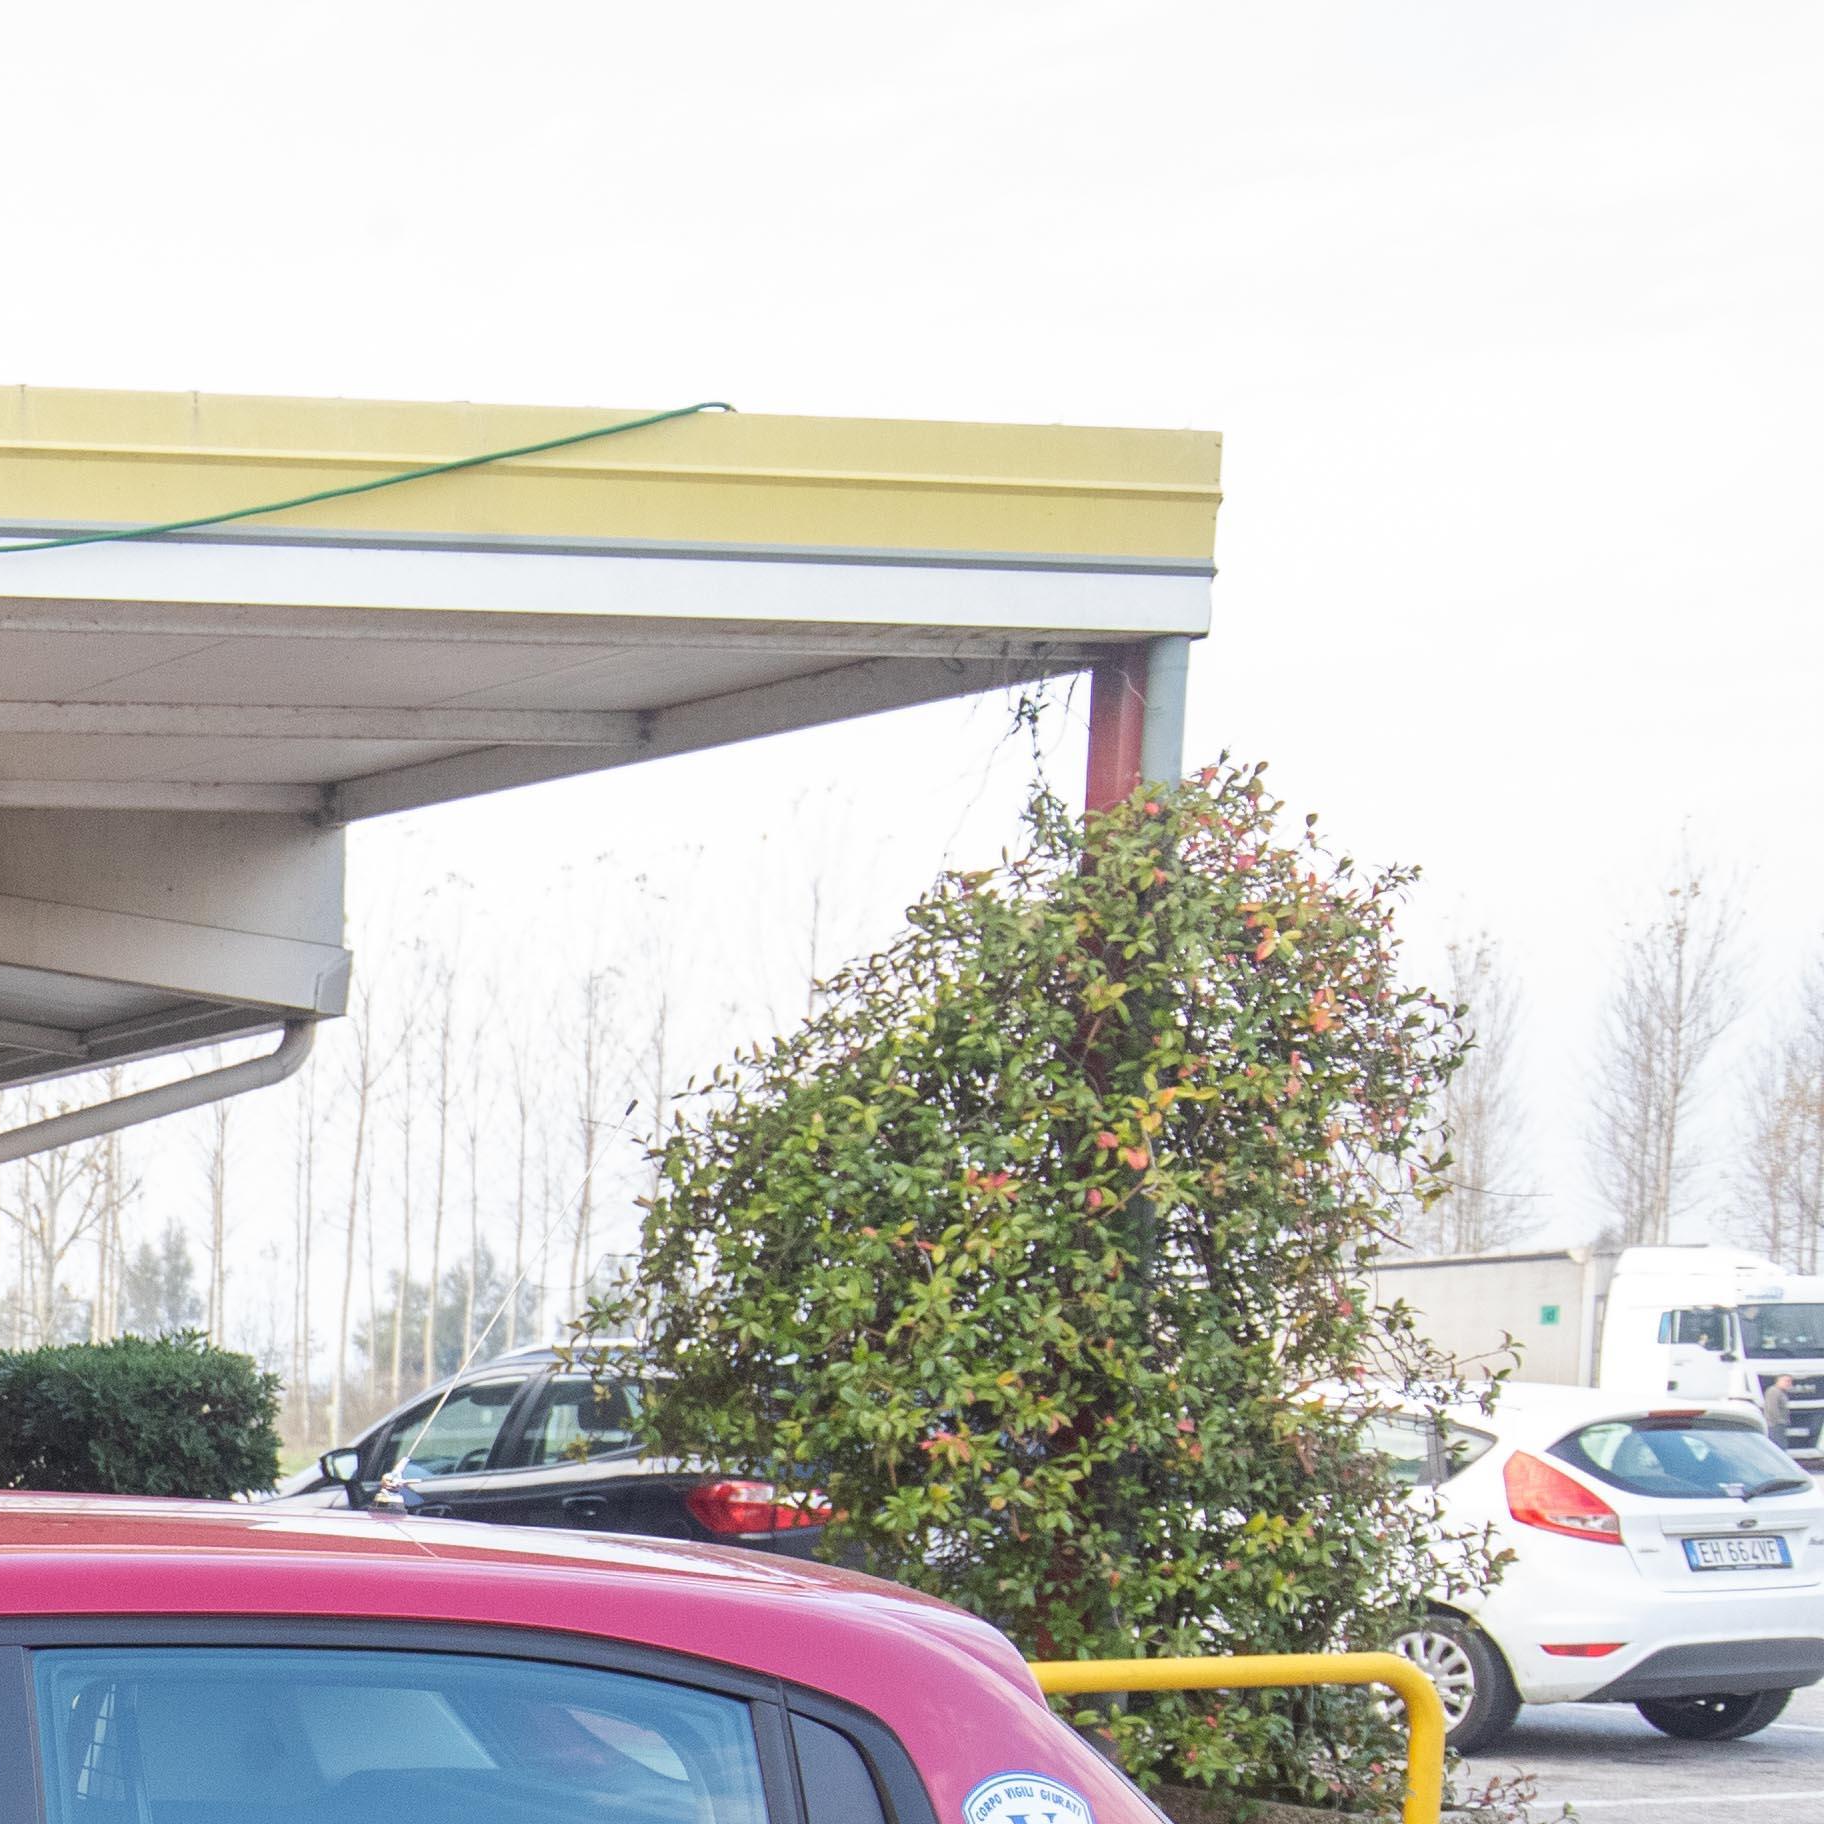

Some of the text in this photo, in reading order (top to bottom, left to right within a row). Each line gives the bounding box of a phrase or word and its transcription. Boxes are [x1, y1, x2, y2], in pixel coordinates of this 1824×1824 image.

[975, 1786, 1082, 1822] CORPO VIGILI GIURATI
